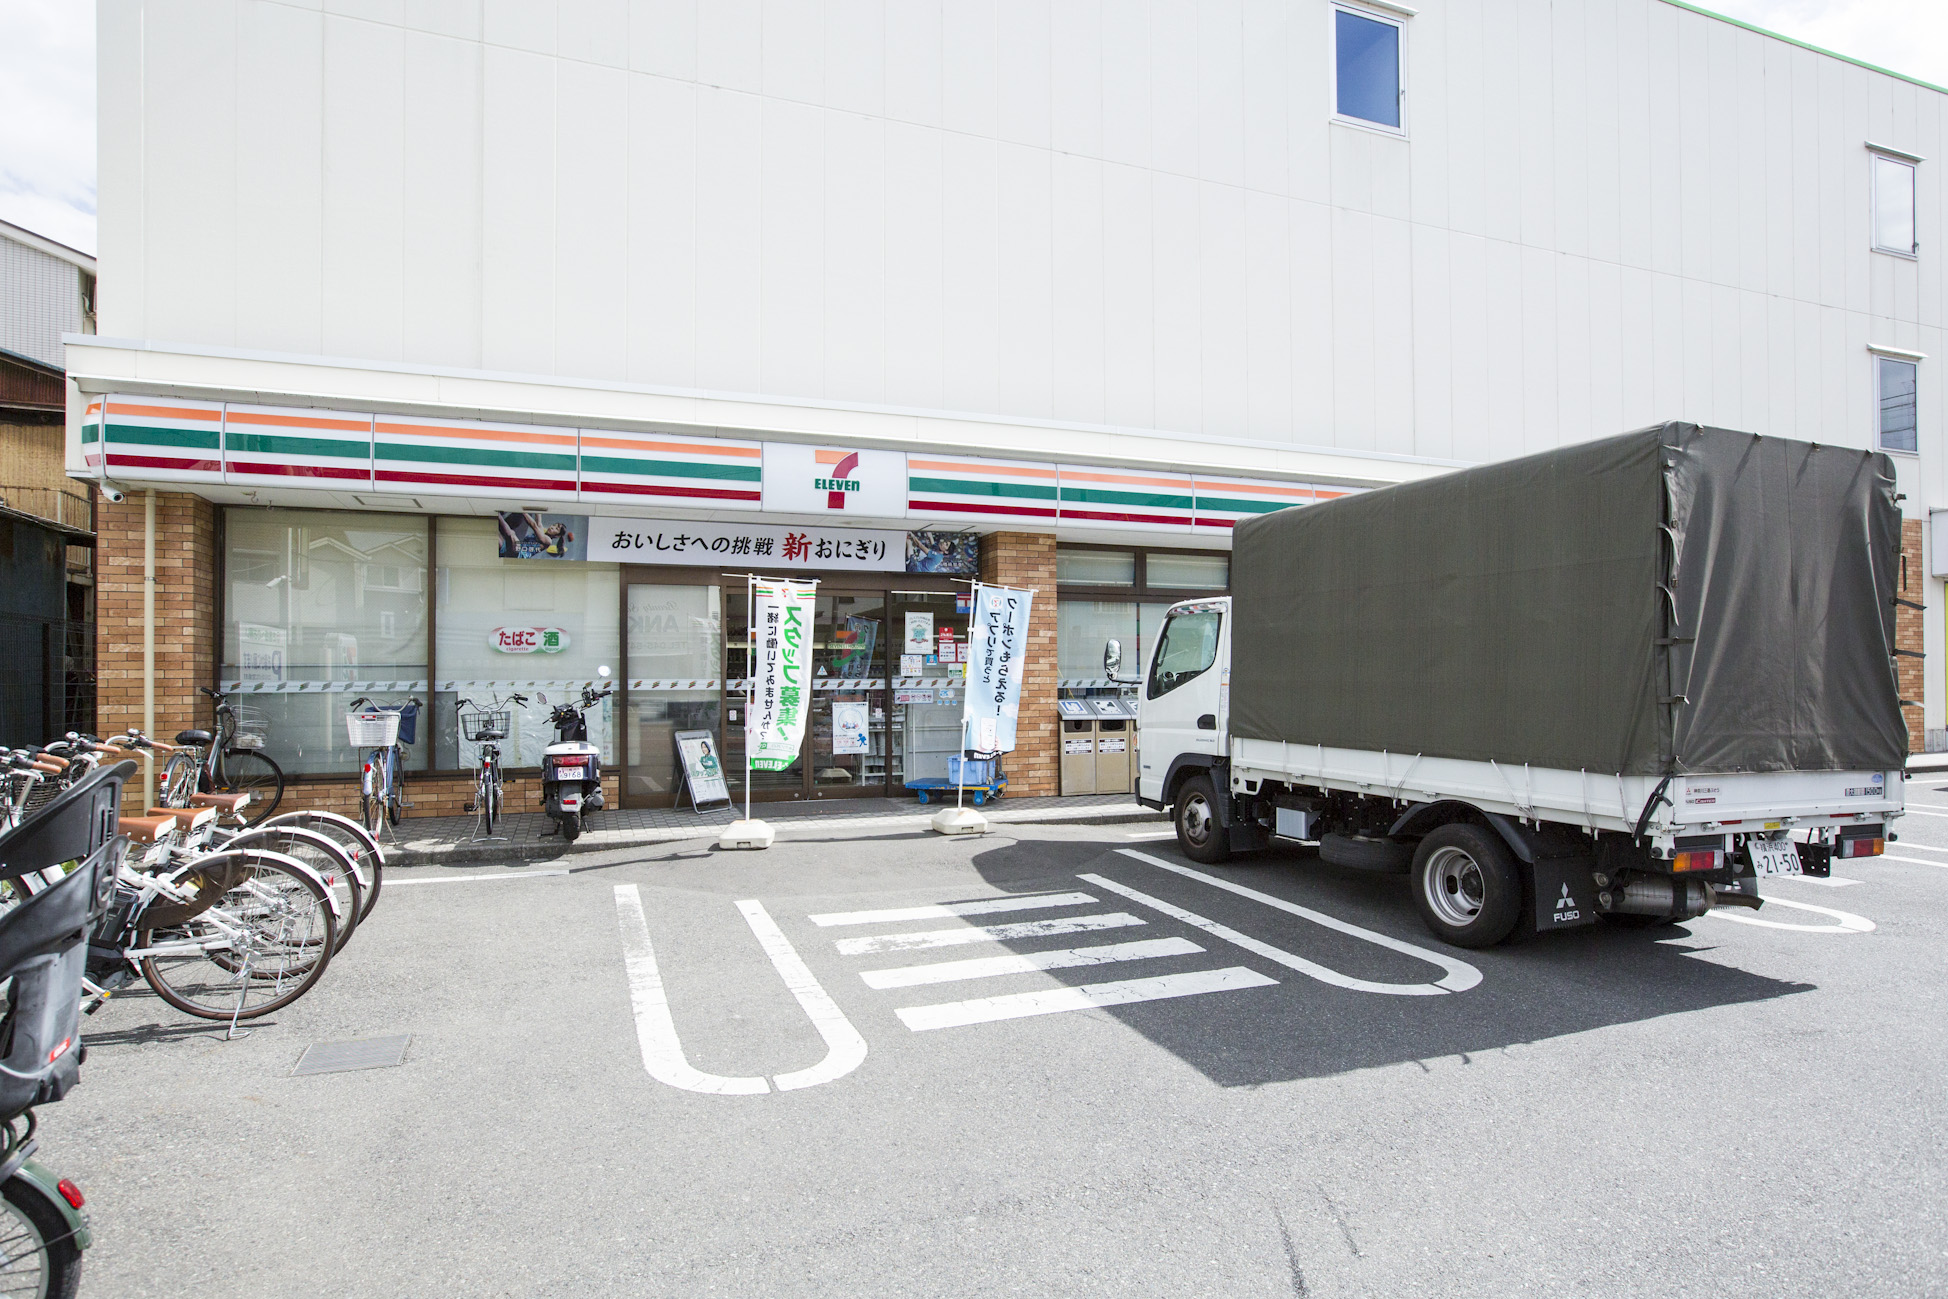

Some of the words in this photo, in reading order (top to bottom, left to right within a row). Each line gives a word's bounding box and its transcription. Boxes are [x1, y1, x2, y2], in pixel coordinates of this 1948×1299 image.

[611, 530, 774, 556] おいしさへの挑戦
[781, 532, 886, 563] 新おにぎり
[499, 630, 537, 646] たばこ
[543, 631, 559, 647] 酒
[1763, 853, 1800, 874] 21-50
[1553, 910, 1580, 922] FUSO
